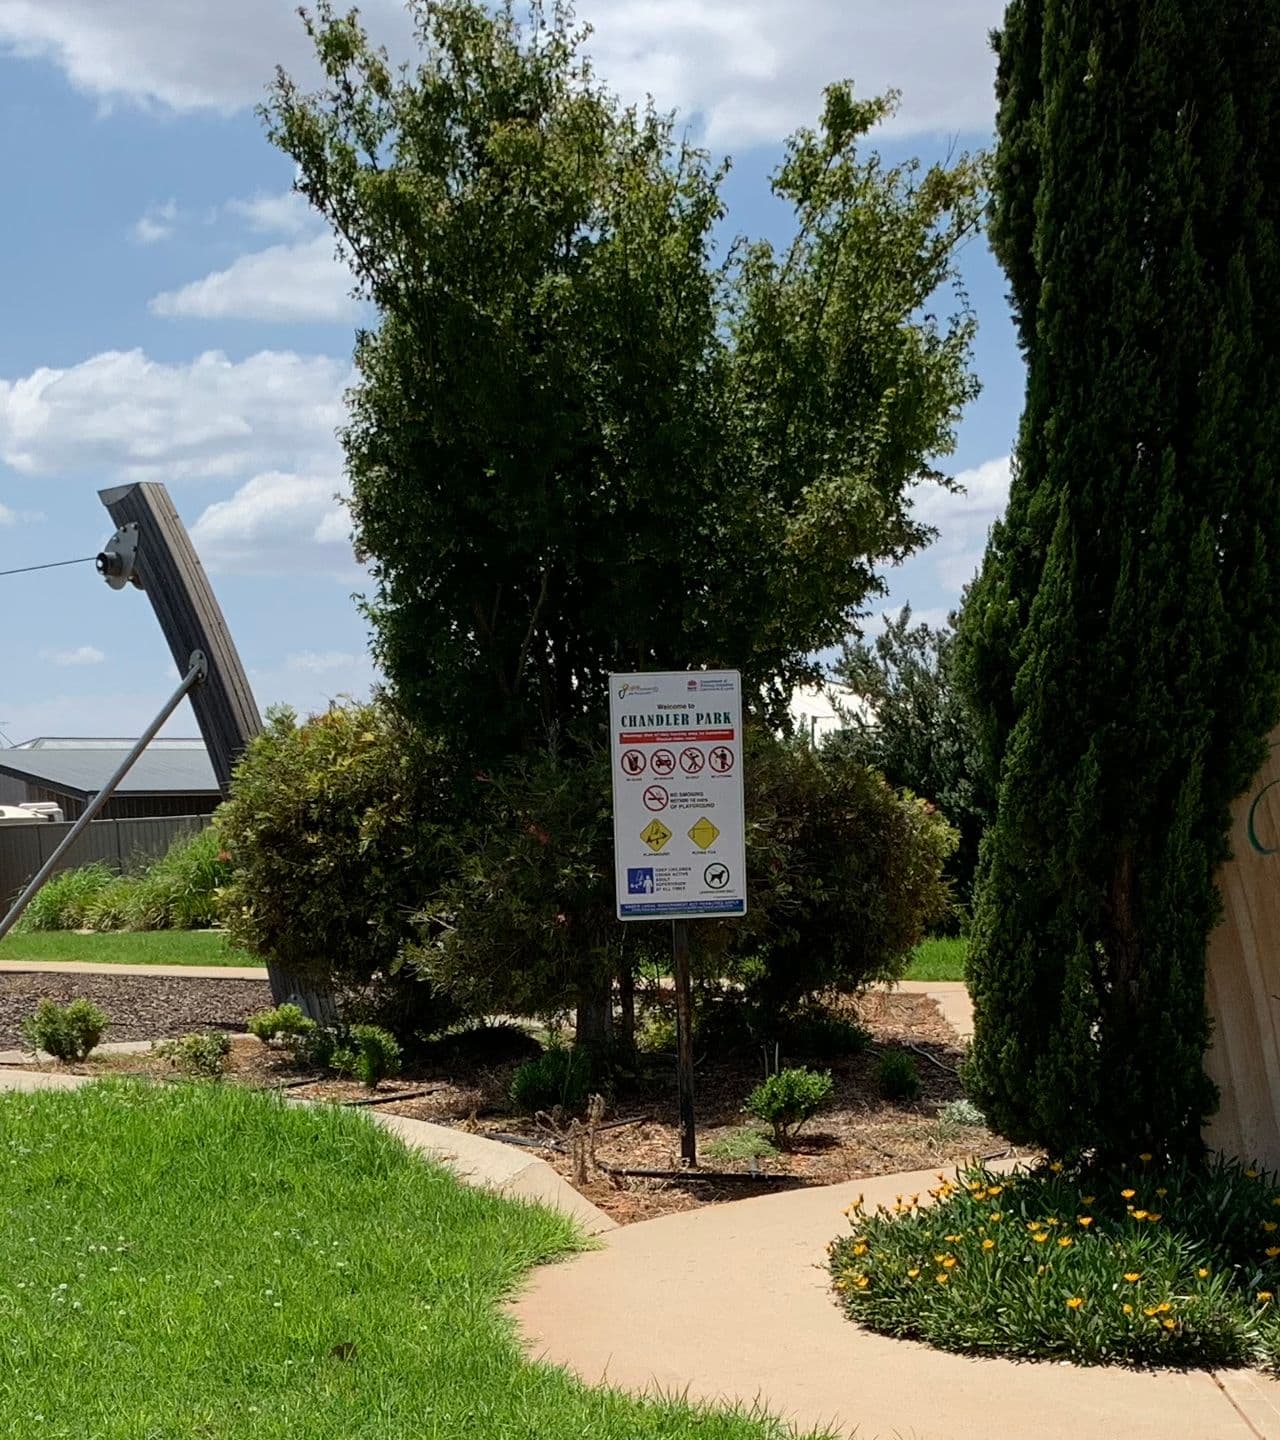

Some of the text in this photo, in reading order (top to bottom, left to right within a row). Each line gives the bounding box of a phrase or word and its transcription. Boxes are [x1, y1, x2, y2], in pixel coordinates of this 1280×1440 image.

[688, 702, 695, 710] to
[621, 711, 732, 728] CHANDLER PARK
